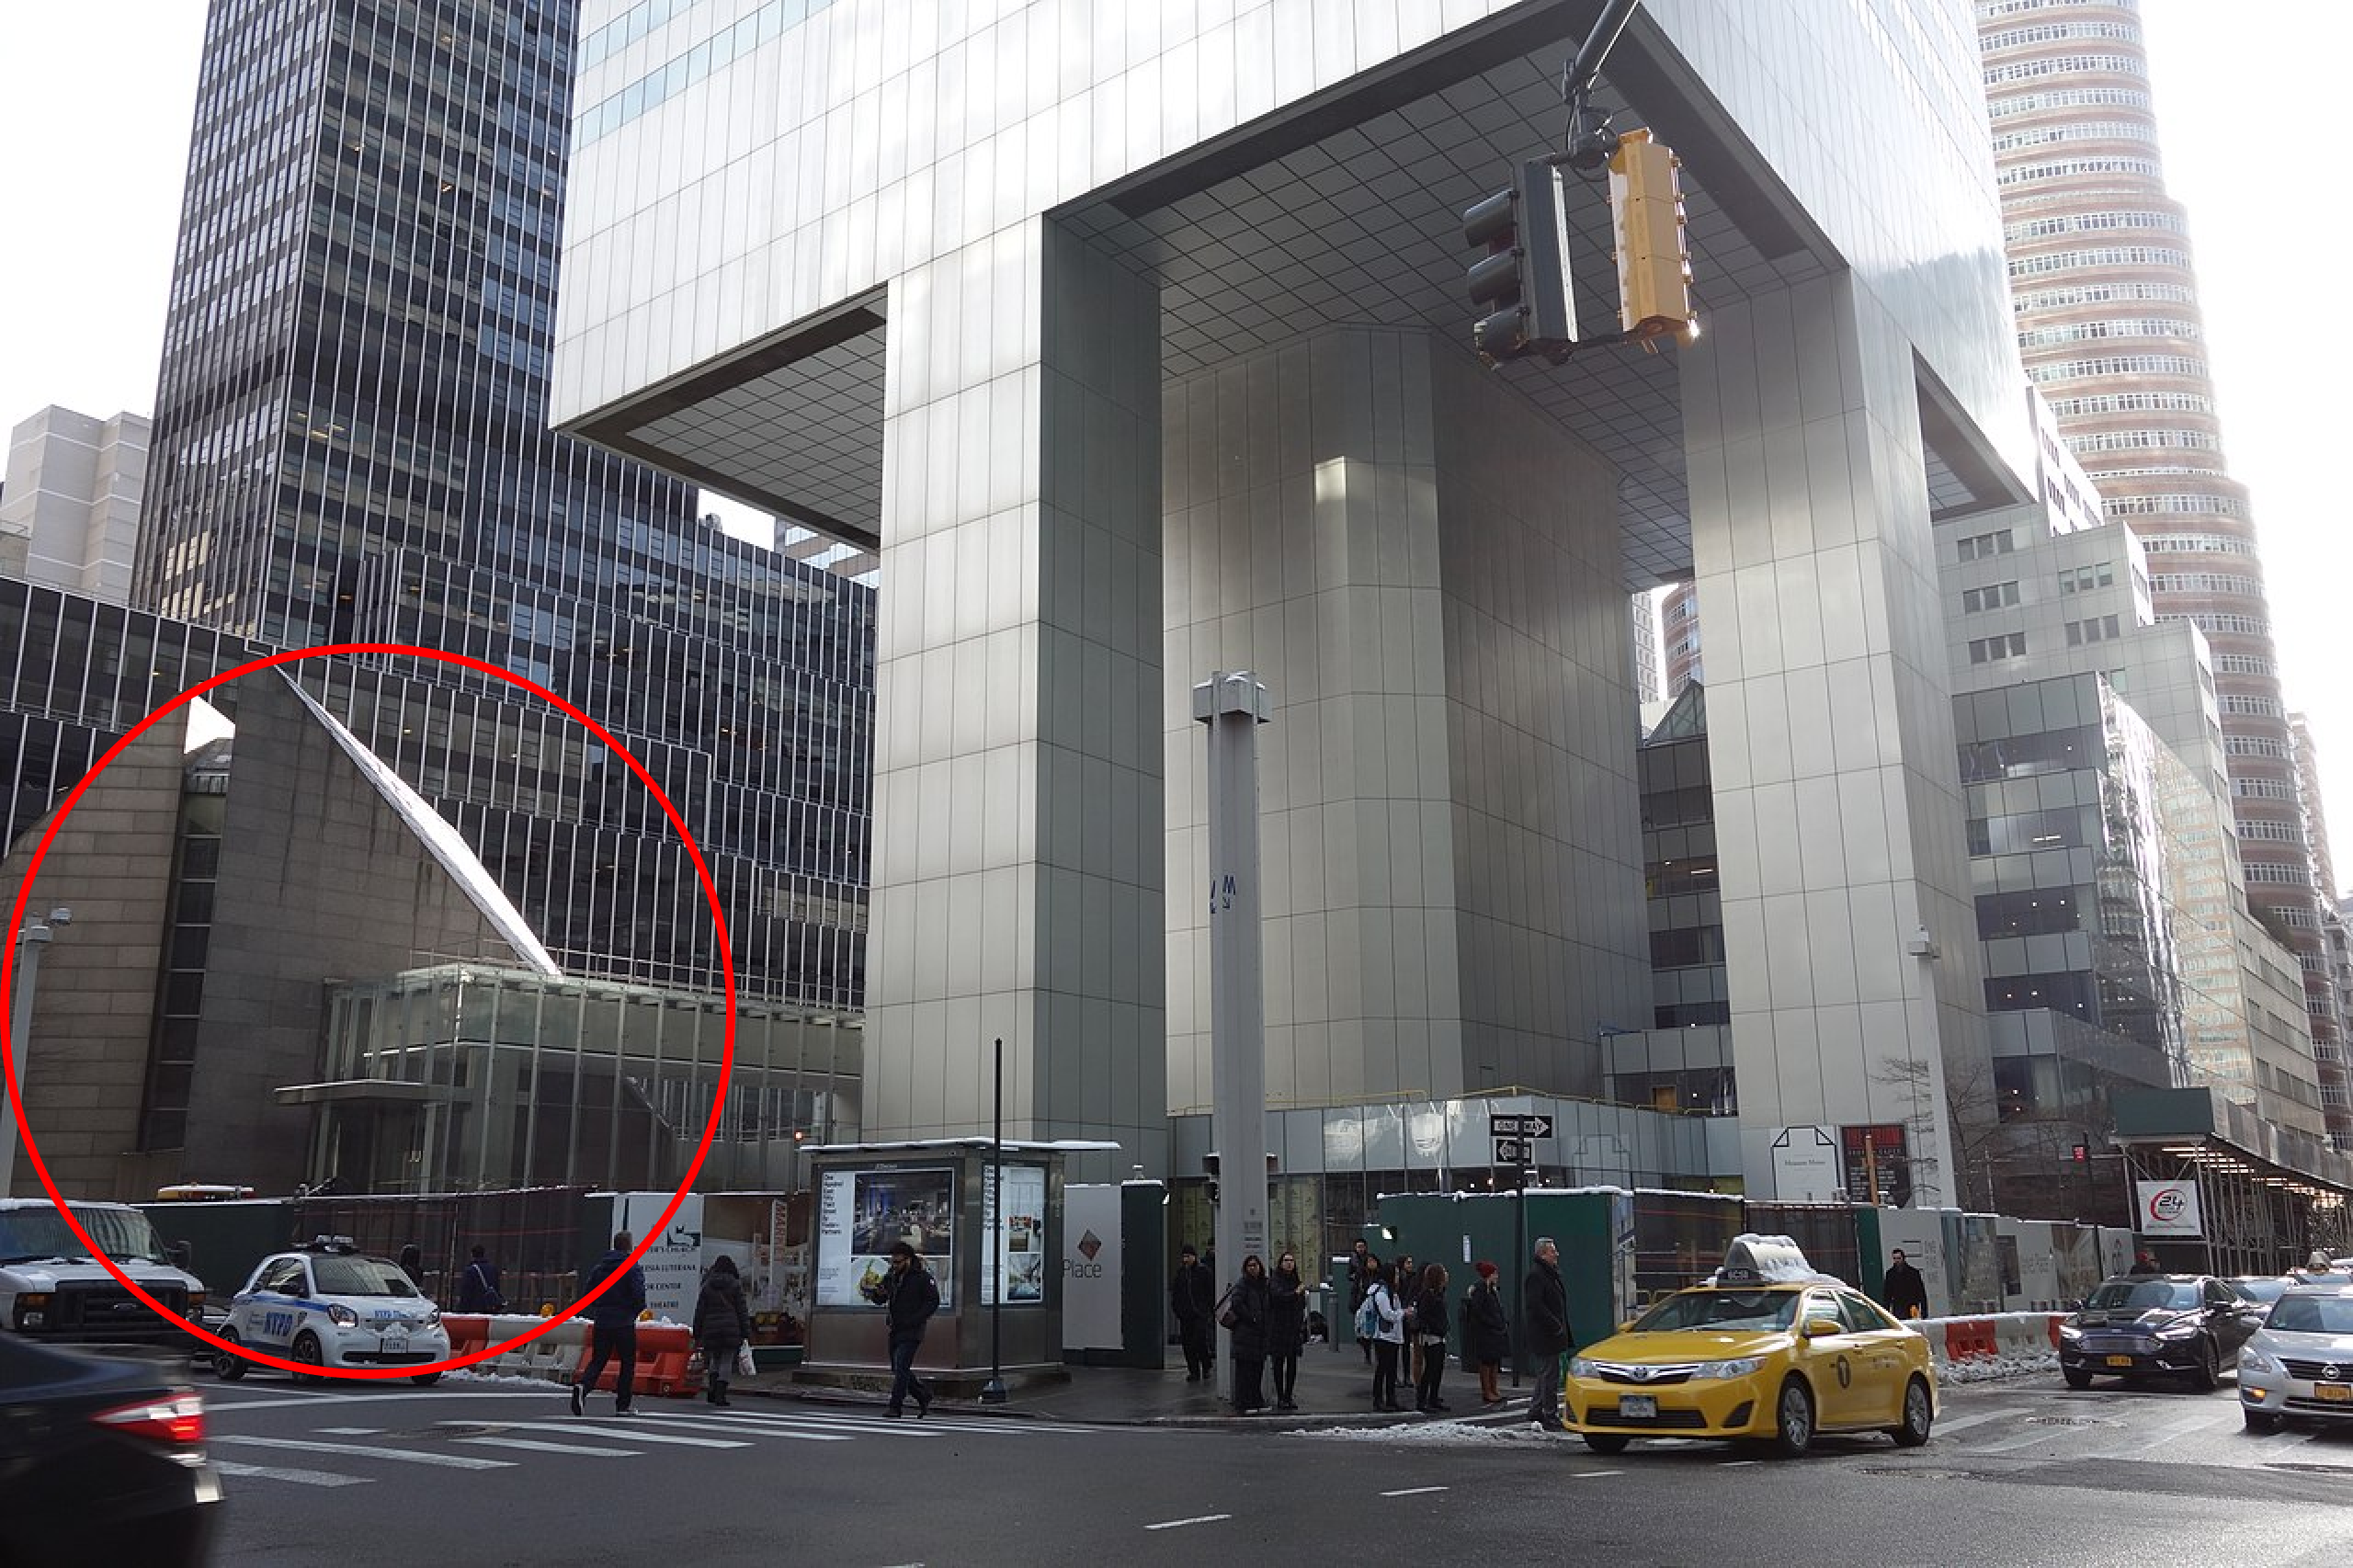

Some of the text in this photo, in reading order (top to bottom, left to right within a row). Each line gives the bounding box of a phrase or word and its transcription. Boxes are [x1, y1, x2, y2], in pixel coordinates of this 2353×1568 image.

[1497, 1120, 1516, 1131] ONE
[2159, 1196, 2185, 1210] 24
[1062, 1258, 1102, 1278] Place
[263, 1312, 293, 1336] NYPD
